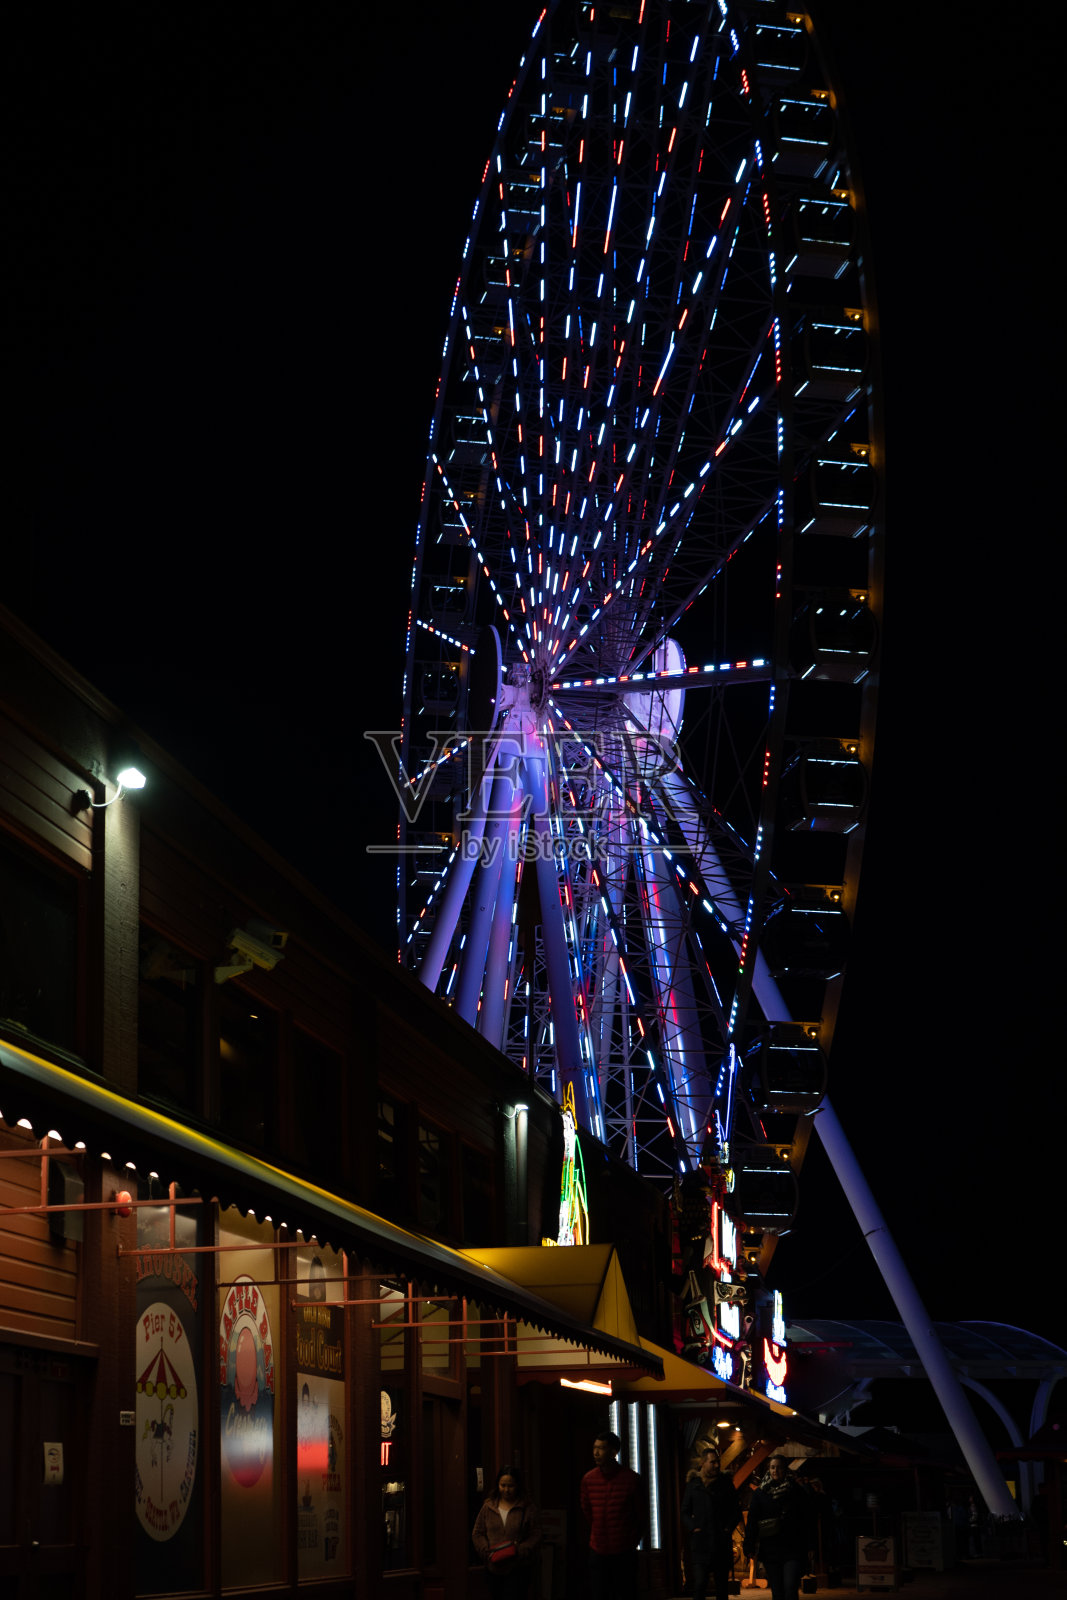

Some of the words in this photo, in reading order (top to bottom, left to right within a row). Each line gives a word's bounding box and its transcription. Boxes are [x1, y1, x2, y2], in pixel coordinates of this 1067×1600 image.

[143, 1313, 165, 1343] Pier
[168, 1312, 182, 1344] 57
[219, 1285, 259, 1386] SEATTLE
[316, 1328, 343, 1374] Court
